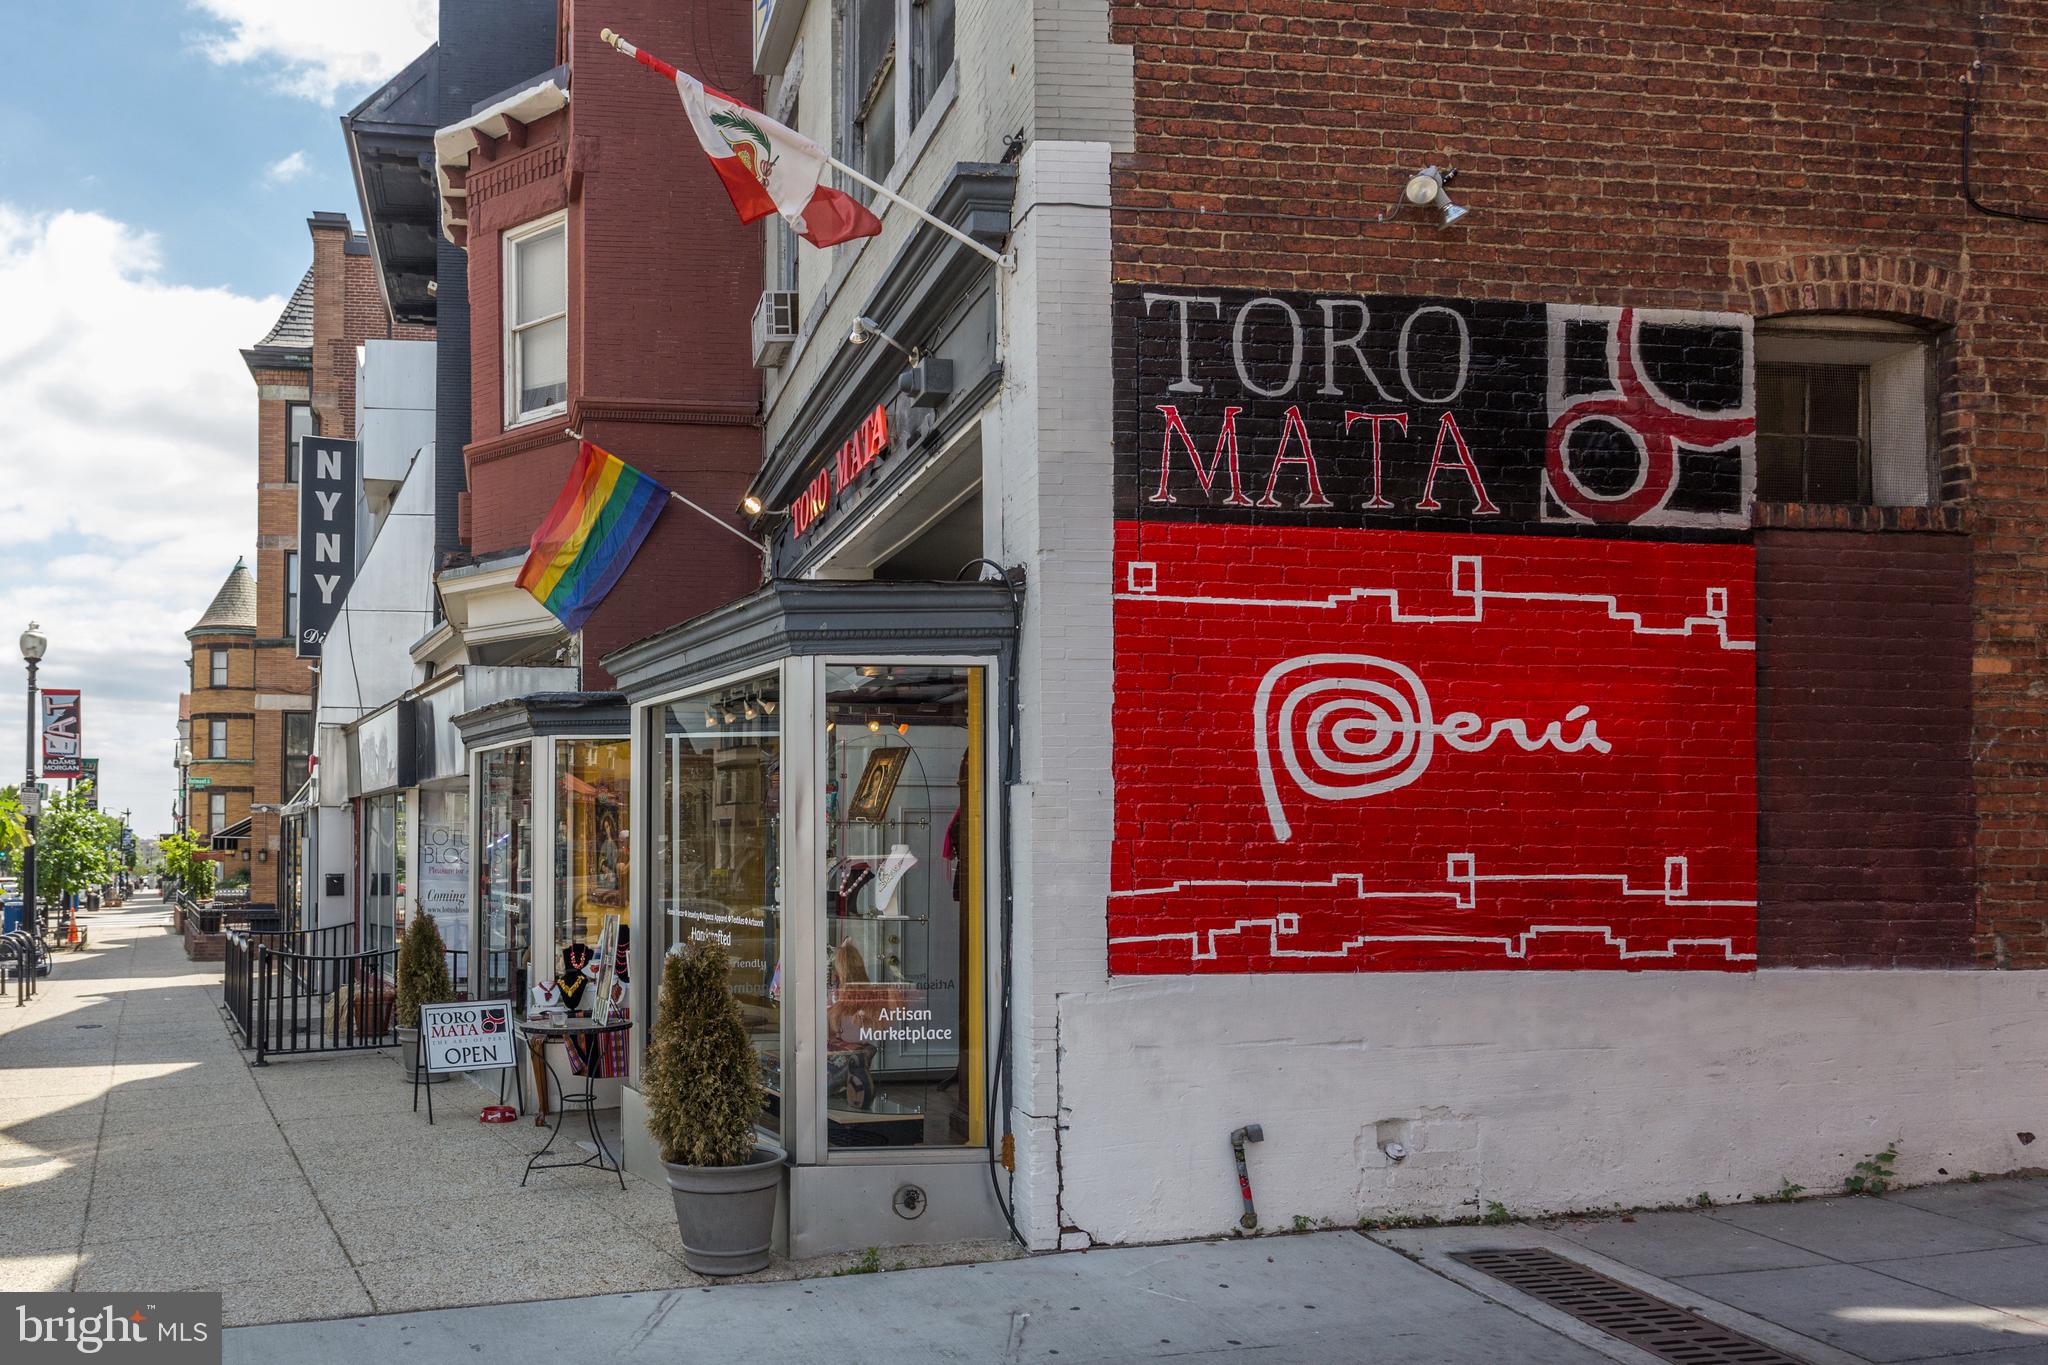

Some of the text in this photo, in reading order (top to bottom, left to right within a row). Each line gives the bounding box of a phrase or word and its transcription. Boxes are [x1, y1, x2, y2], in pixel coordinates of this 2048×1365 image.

[1143, 292, 1470, 403] TORO
[1148, 404, 1500, 515] MATA
[791, 403, 888, 540] TORO MATA
[1254, 652, 1612, 843] Perú
[424, 829, 470, 846] LOTU
[427, 889, 466, 905] Coming
[429, 1011, 476, 1025] TORO
[878, 1006, 932, 1021] Artisan
[431, 1024, 478, 1038] MATA
[859, 1026, 952, 1044] Marketplace
[445, 1045, 498, 1064] OPEN
